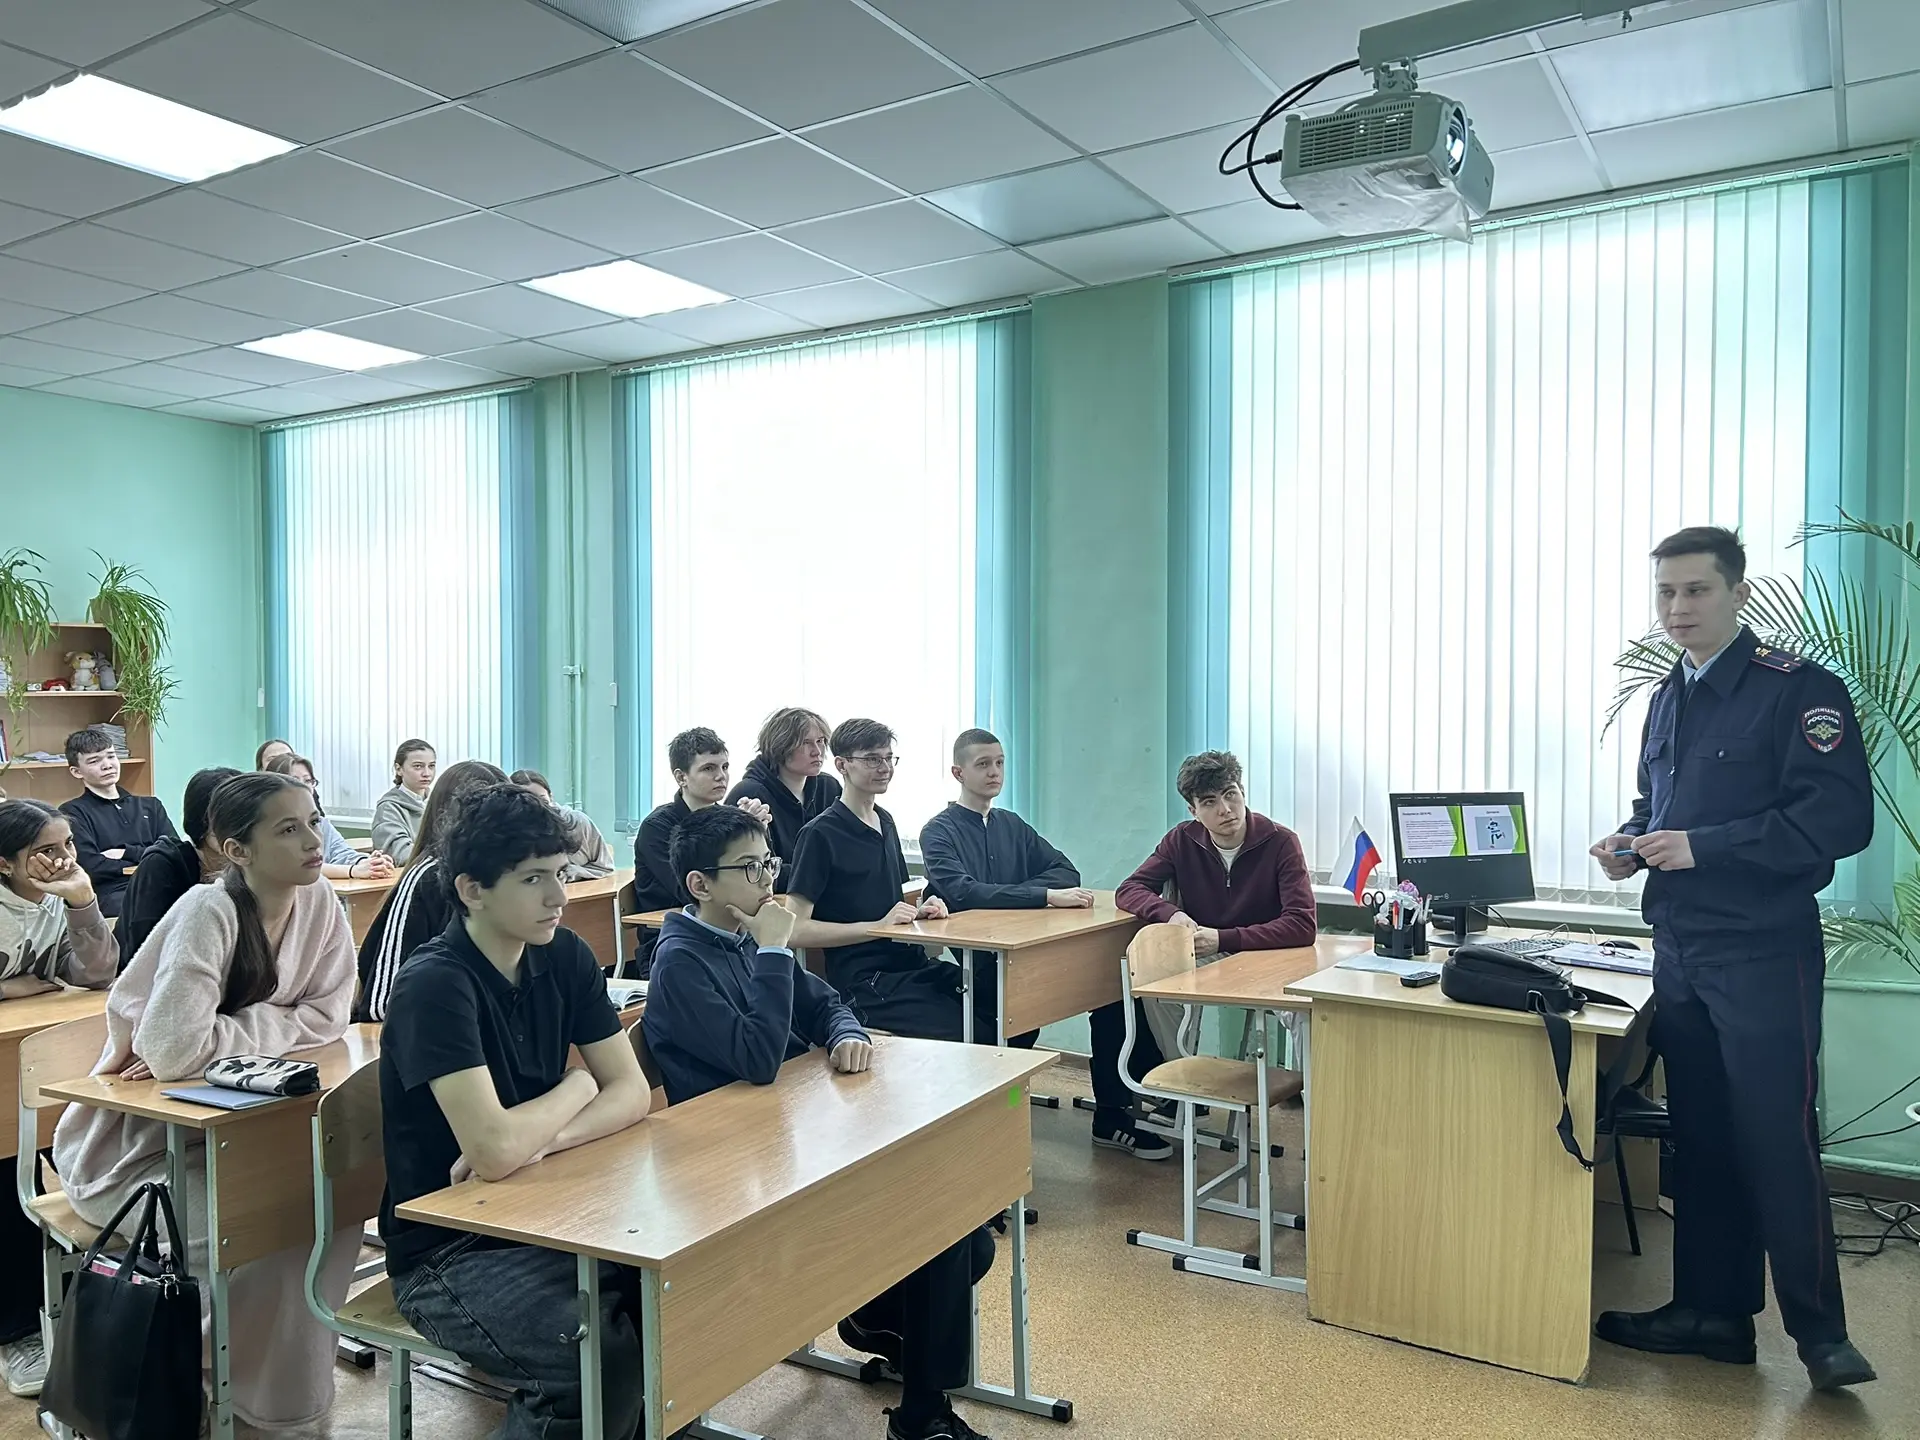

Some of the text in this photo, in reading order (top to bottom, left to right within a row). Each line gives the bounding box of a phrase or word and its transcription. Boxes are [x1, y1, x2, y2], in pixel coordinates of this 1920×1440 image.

[1804, 707, 1841, 718] ПОЛИЦИЯ
[1807, 715, 1839, 725] РОССИЯ
[1817, 744, 1833, 753] МВД
